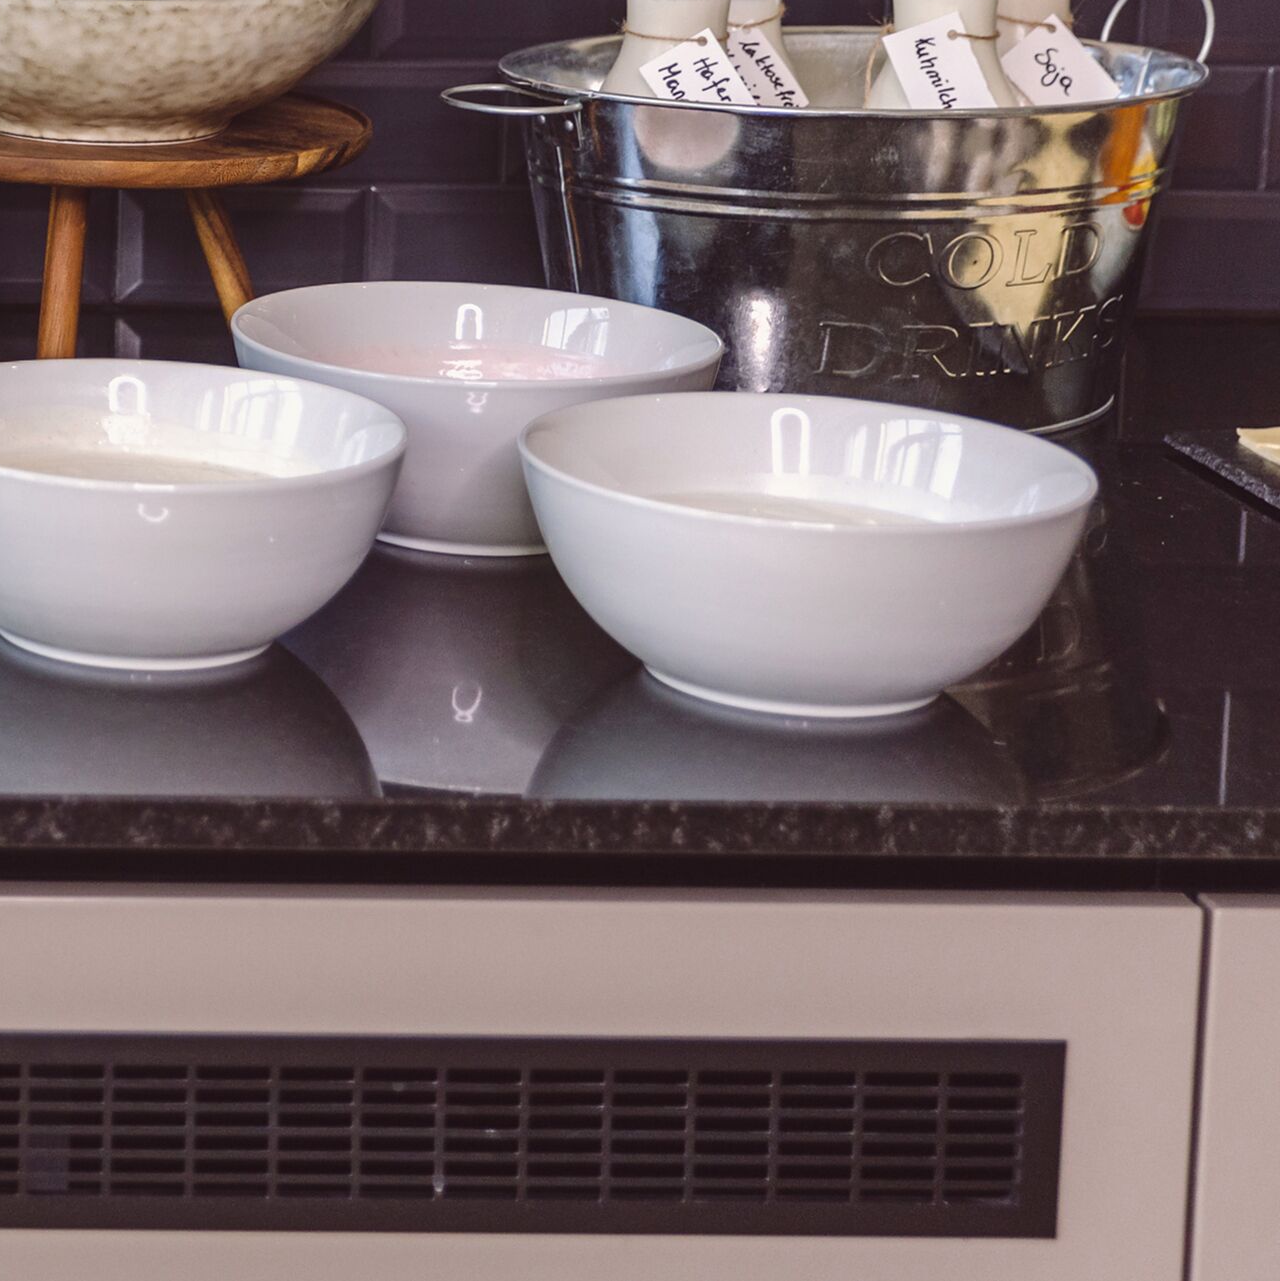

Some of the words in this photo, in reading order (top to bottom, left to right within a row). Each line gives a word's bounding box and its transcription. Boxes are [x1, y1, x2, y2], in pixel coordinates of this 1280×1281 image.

[693, 56, 732, 103] Hafer
[915, 37, 957, 109] Kuhmilch
[1034, 47, 1073, 97] Soja
[865, 221, 1104, 290] COLD
[813, 293, 1124, 379] DRINKS
